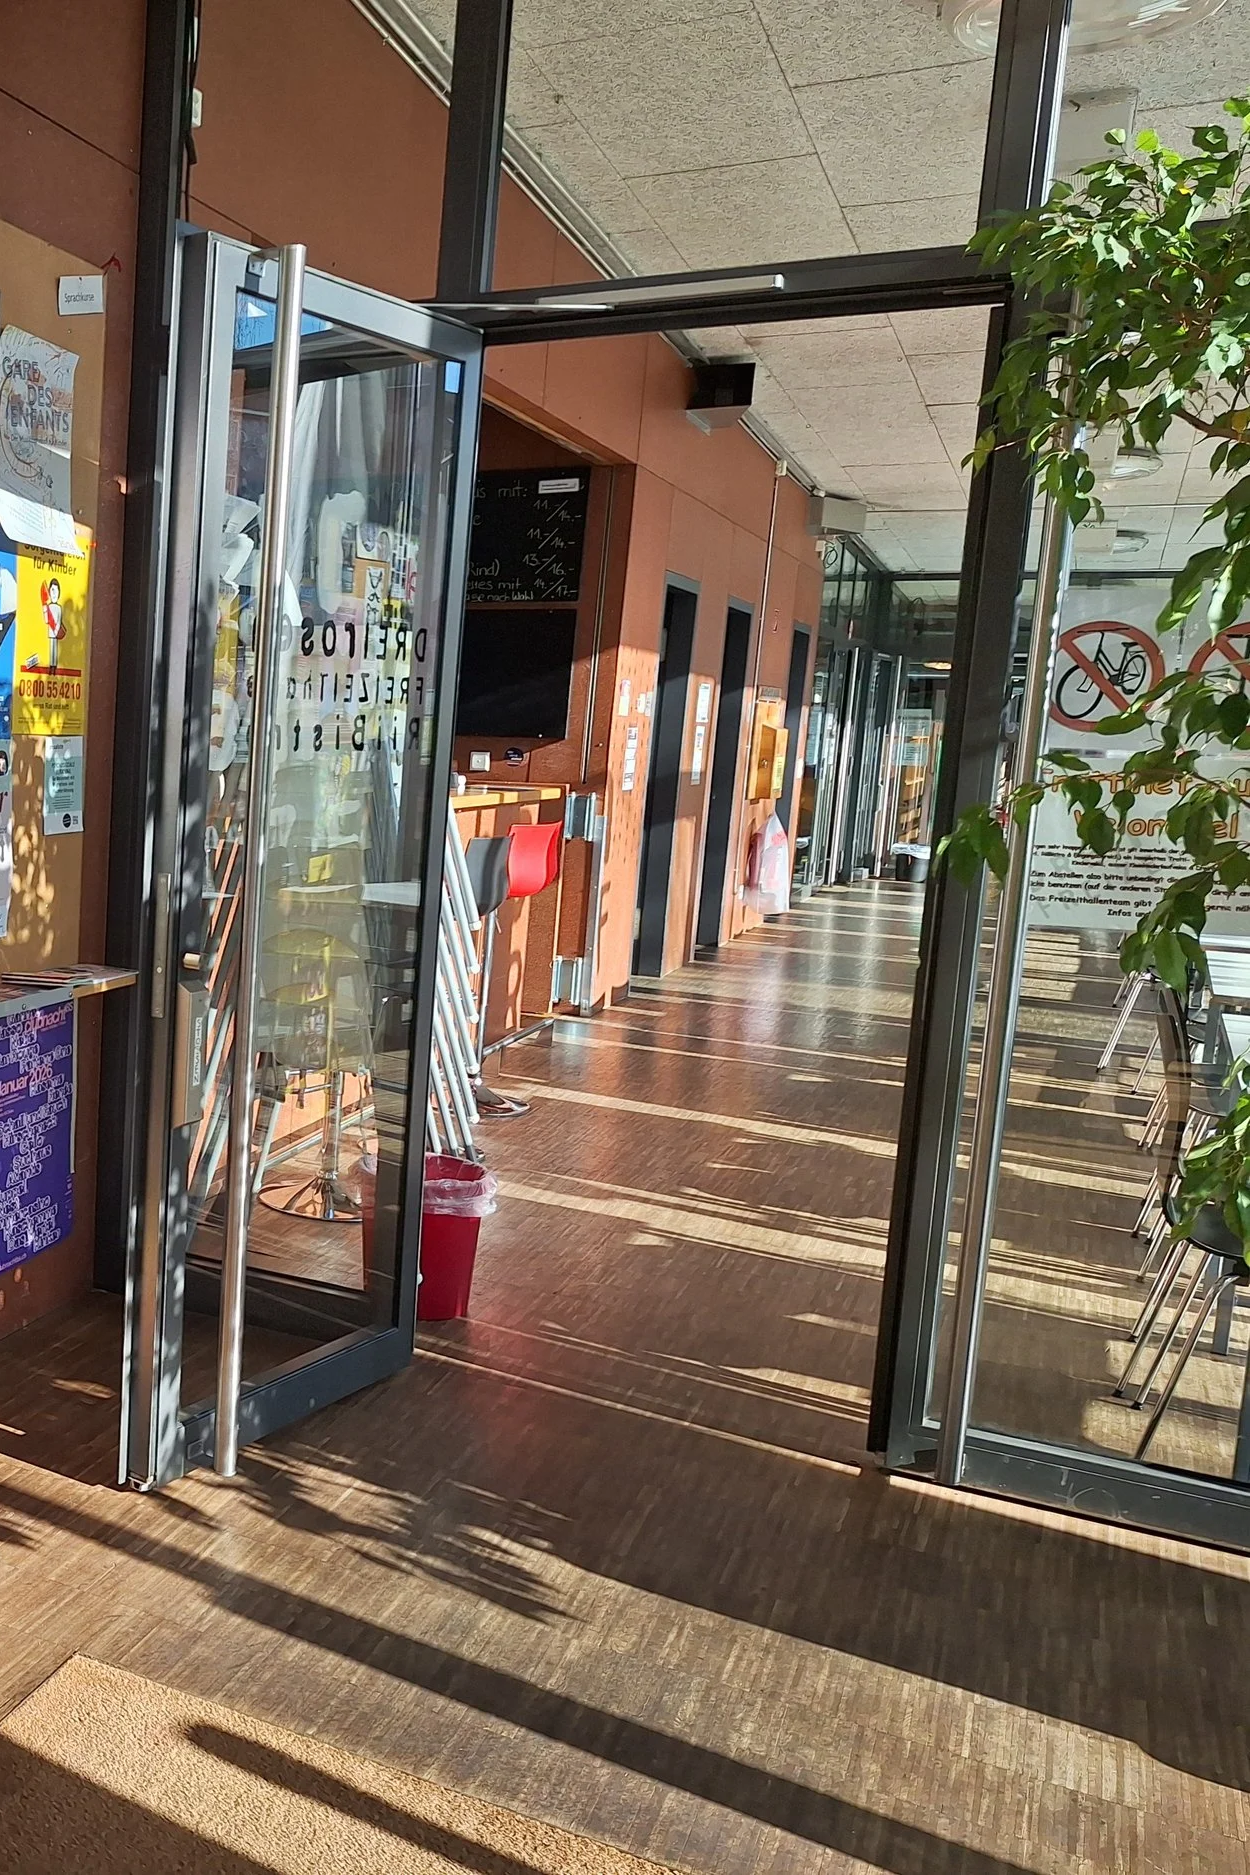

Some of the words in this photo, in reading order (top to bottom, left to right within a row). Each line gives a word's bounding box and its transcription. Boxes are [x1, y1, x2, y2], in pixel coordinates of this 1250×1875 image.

[28, 385, 52, 408] DES
[11, 407, 69, 433] ENFANTS
[498, 480, 528, 497] mit:
[33, 556, 46, 569] für
[48, 561, 77, 575] Kinder
[498, 578, 521, 589] mit
[19, 679, 44, 698] 0800
[46, 681, 58, 698] 55
[1104, 873, 1123, 881] bitte
[1126, 875, 1164, 884] unbedingt
[1084, 882, 1099, 891] (auf
[1119, 885, 1151, 893] anderen
[1049, 895, 1130, 906] Freizeithallenteam
[1134, 899, 1152, 908] gibt
[30, 1064, 53, 1082] 2026
